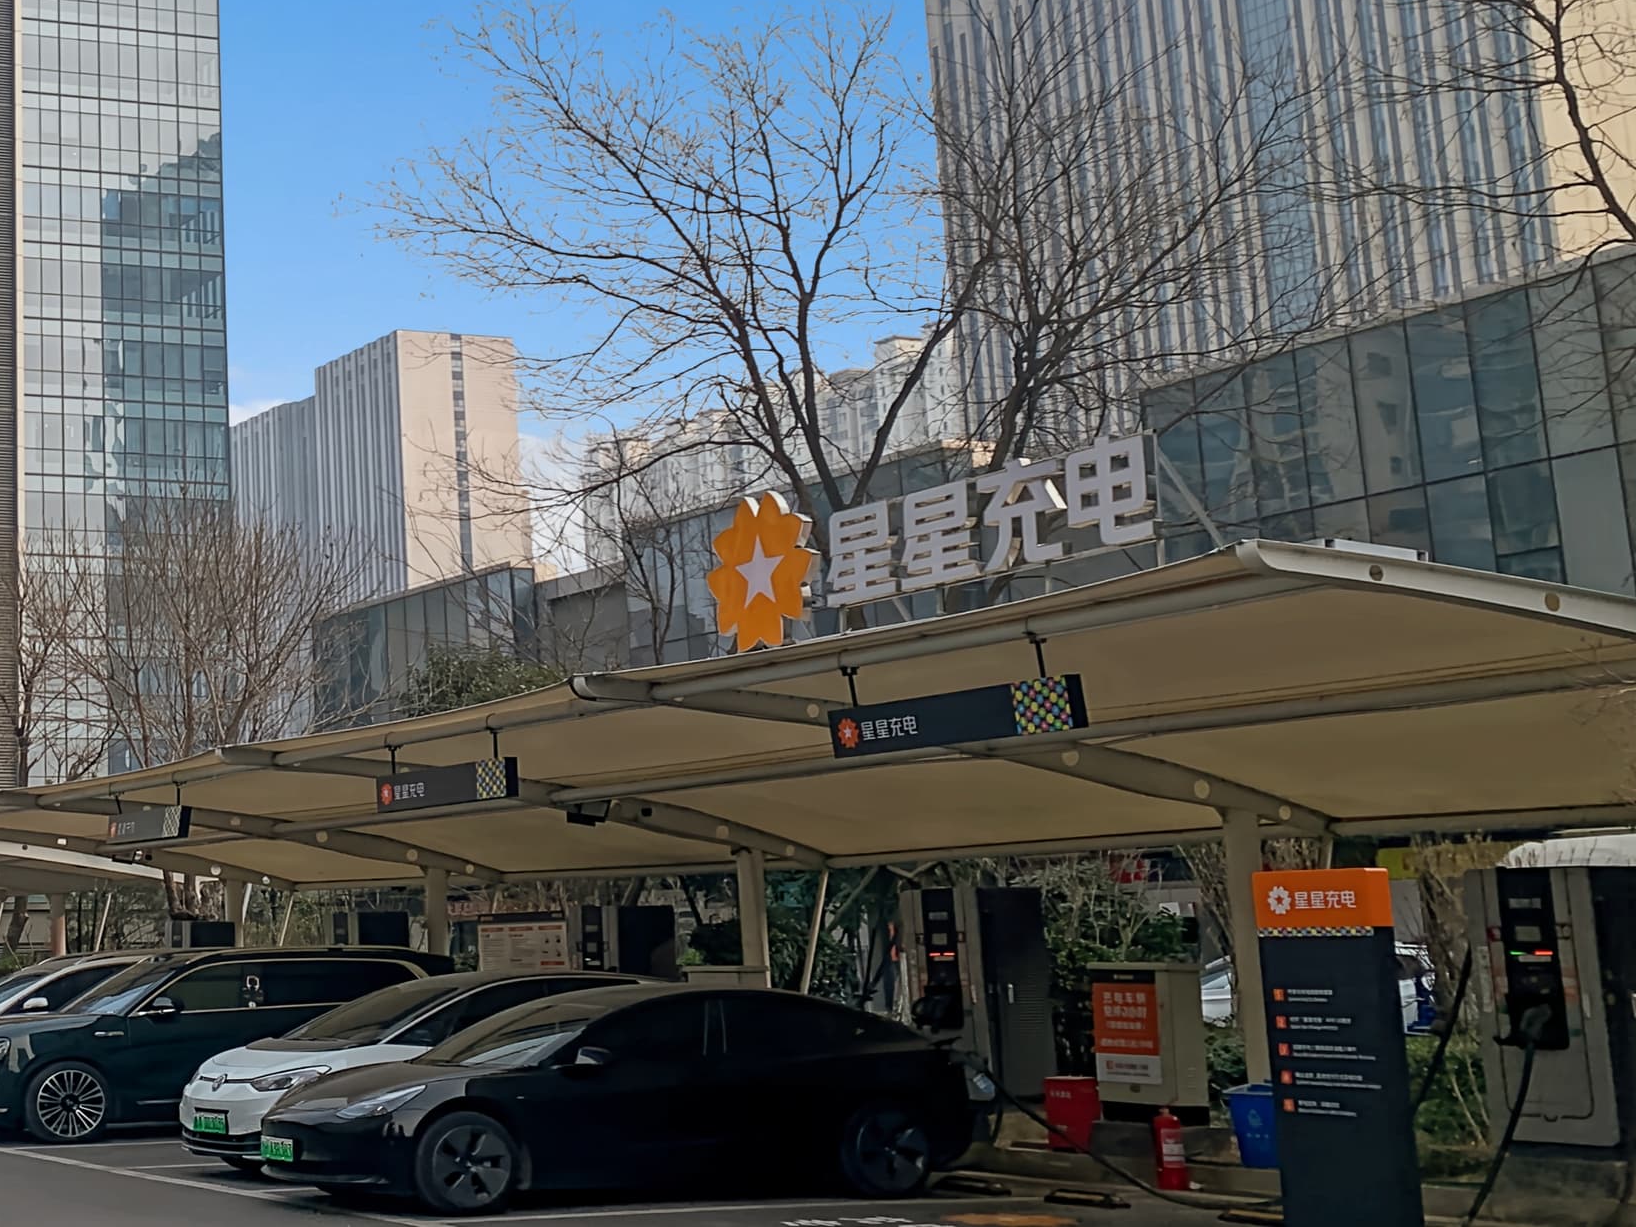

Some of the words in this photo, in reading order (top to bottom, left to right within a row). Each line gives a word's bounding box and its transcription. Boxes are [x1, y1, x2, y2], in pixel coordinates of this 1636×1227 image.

[826, 434, 1157, 608] 星星充电
[861, 716, 918, 741] 星星充电
[1294, 890, 1357, 909] 星星充电
